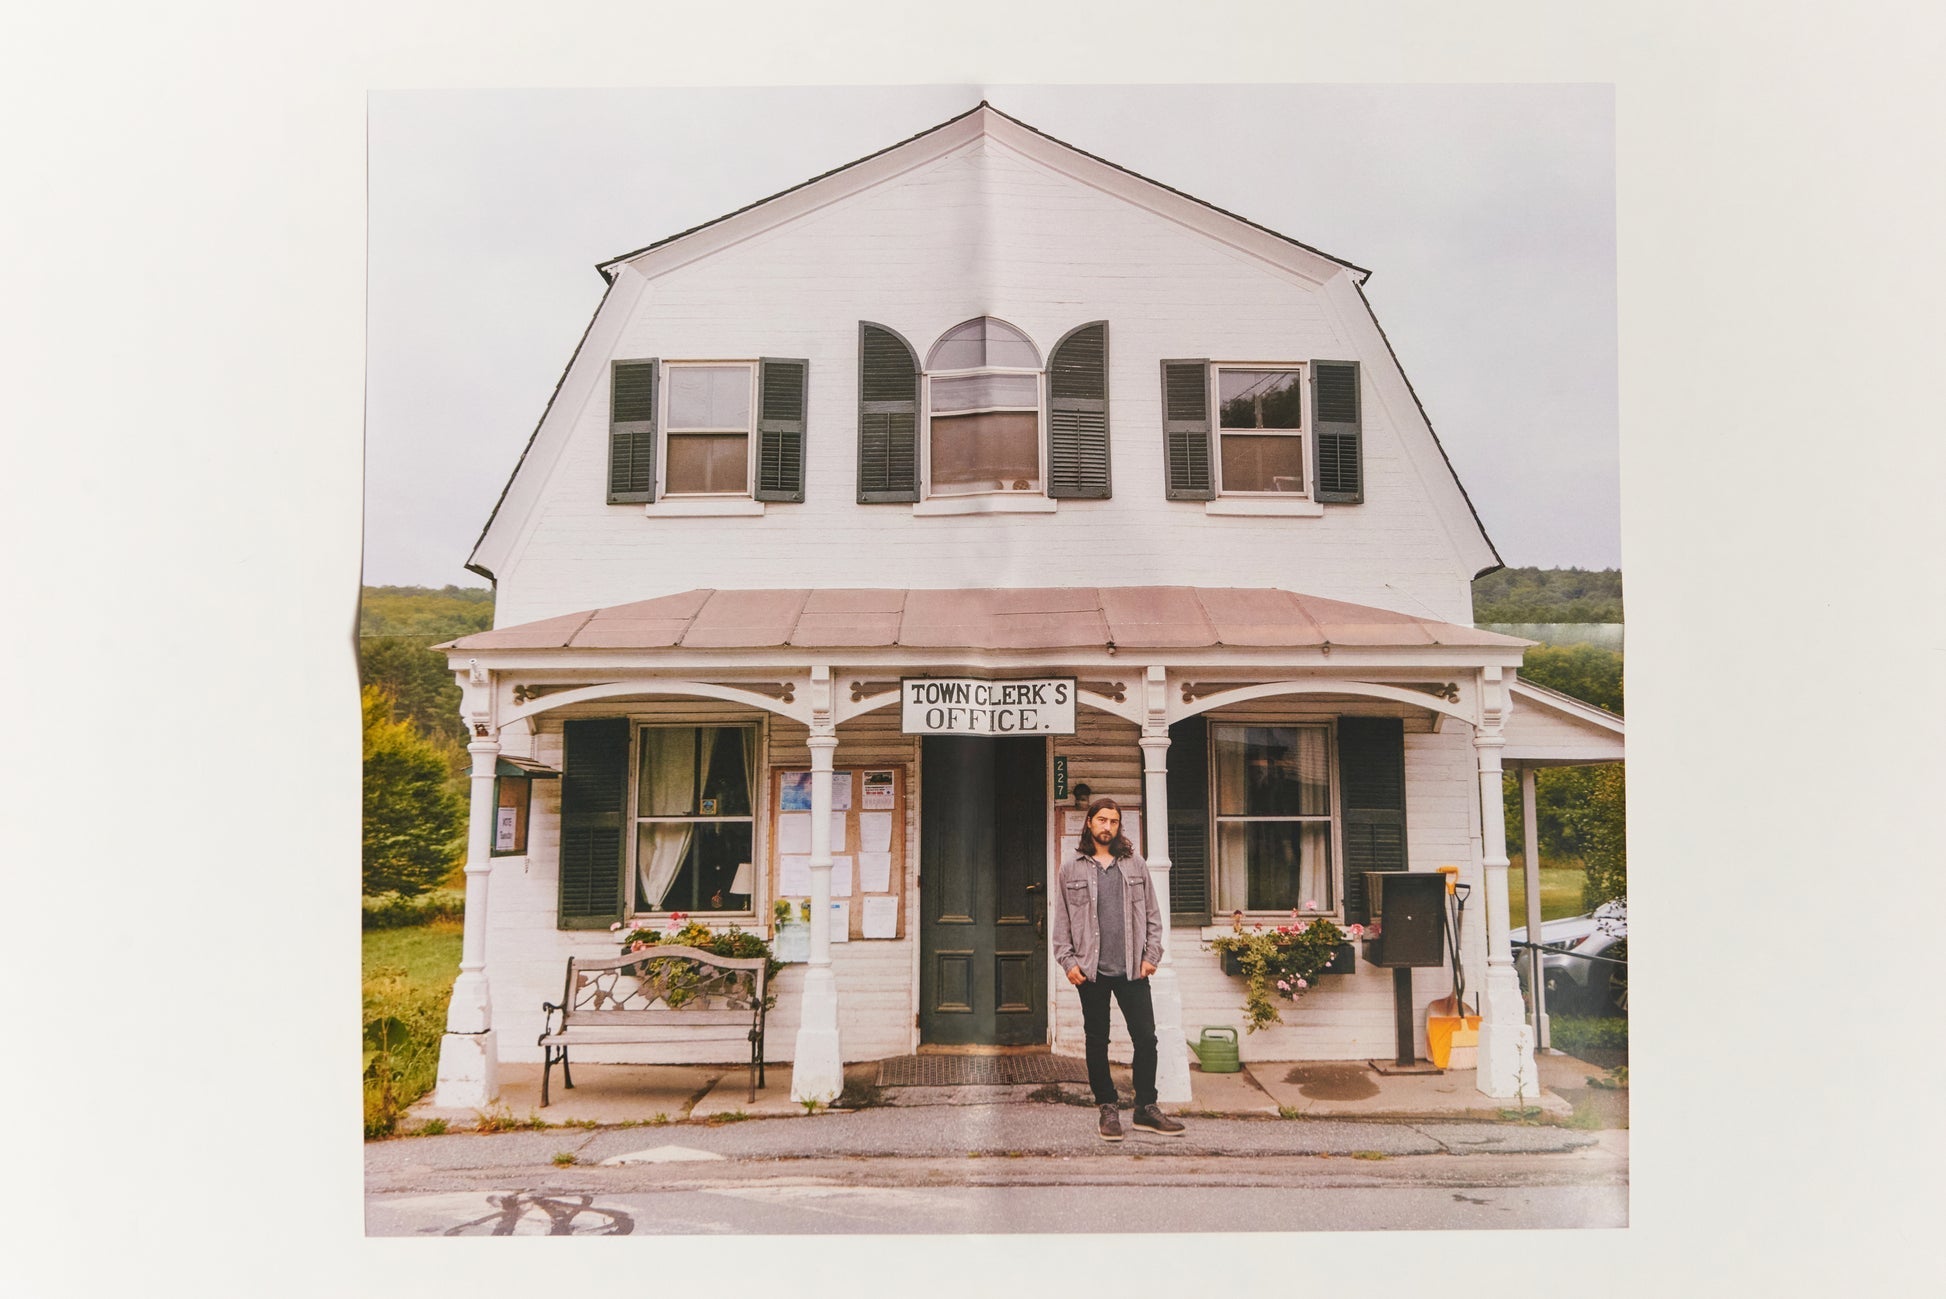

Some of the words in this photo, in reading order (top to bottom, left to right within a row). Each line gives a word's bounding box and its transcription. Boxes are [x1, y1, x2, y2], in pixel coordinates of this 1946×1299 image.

[911, 683, 971, 704] TOWN
[975, 683, 1067, 706] CLERK'S
[926, 708, 1050, 732] OFFICE.
